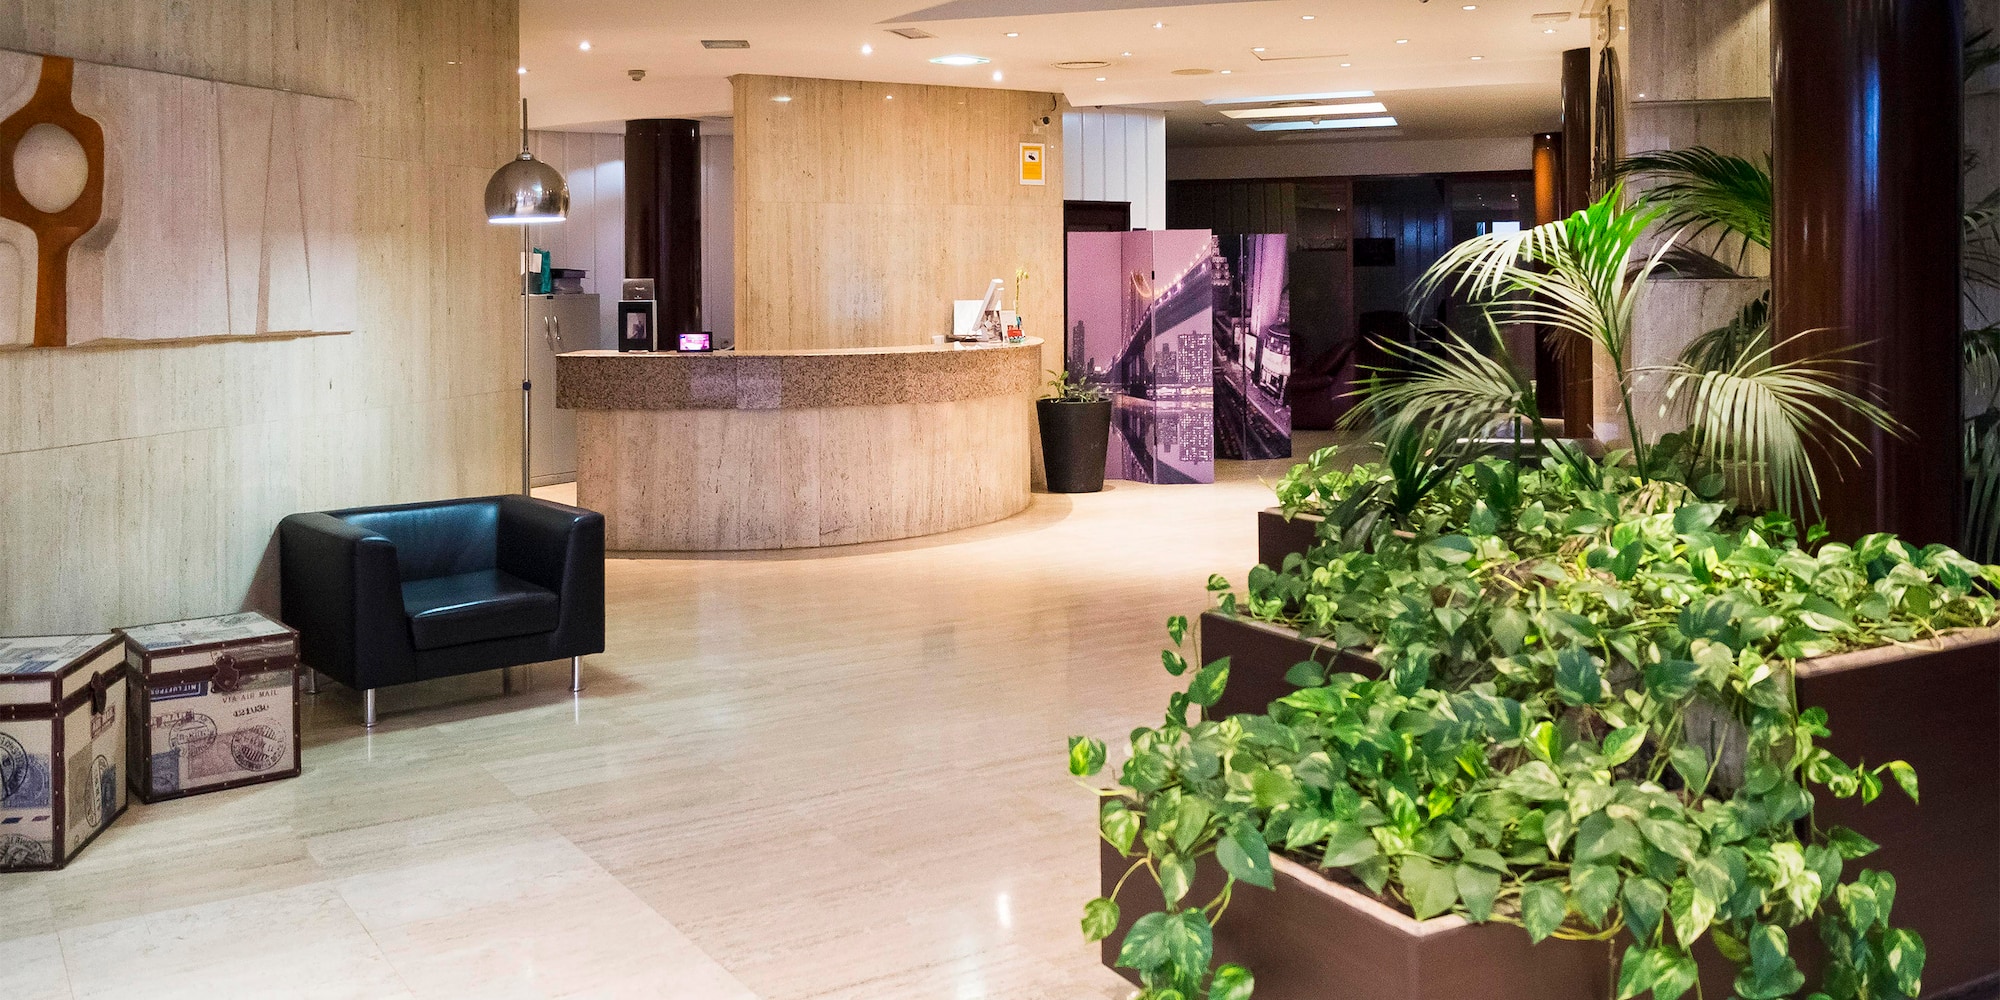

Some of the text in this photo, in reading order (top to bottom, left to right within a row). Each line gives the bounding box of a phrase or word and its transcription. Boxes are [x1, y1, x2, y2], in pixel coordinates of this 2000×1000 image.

[184, 684, 197, 692] MIT
[222, 689, 278, 704] VIA AIR MAIL
